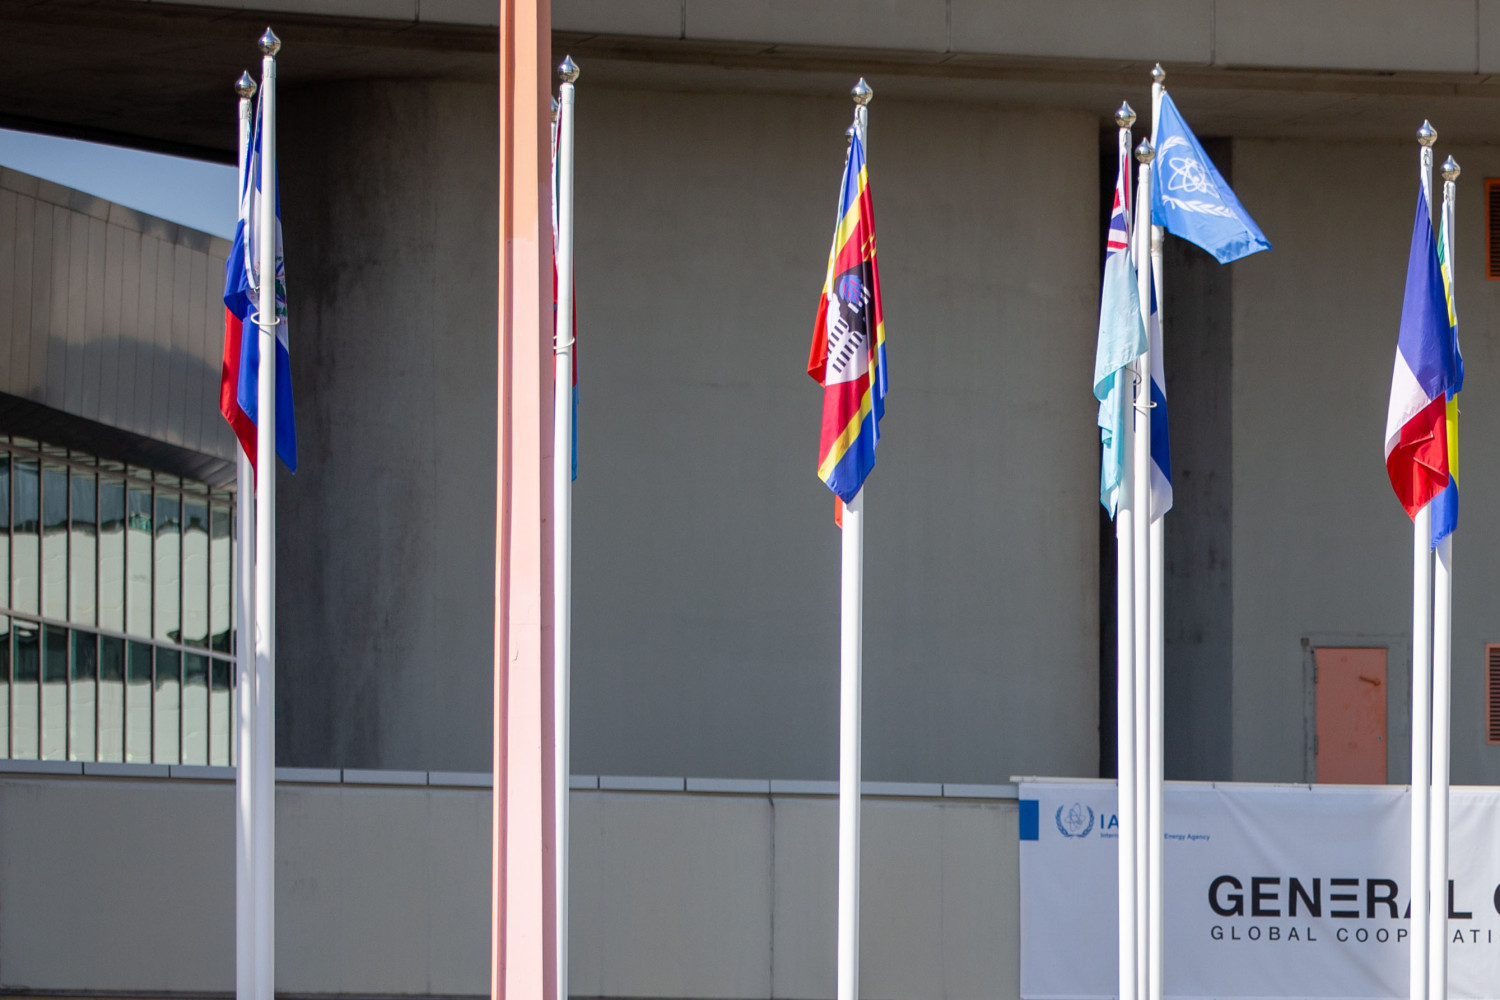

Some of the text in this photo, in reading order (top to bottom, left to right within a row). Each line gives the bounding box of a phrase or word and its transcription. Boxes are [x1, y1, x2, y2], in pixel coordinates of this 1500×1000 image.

[1187, 833, 1210, 842] Agency
[1208, 874, 1473, 920] GENERL
[1210, 925, 1317, 942] GLOBAL
